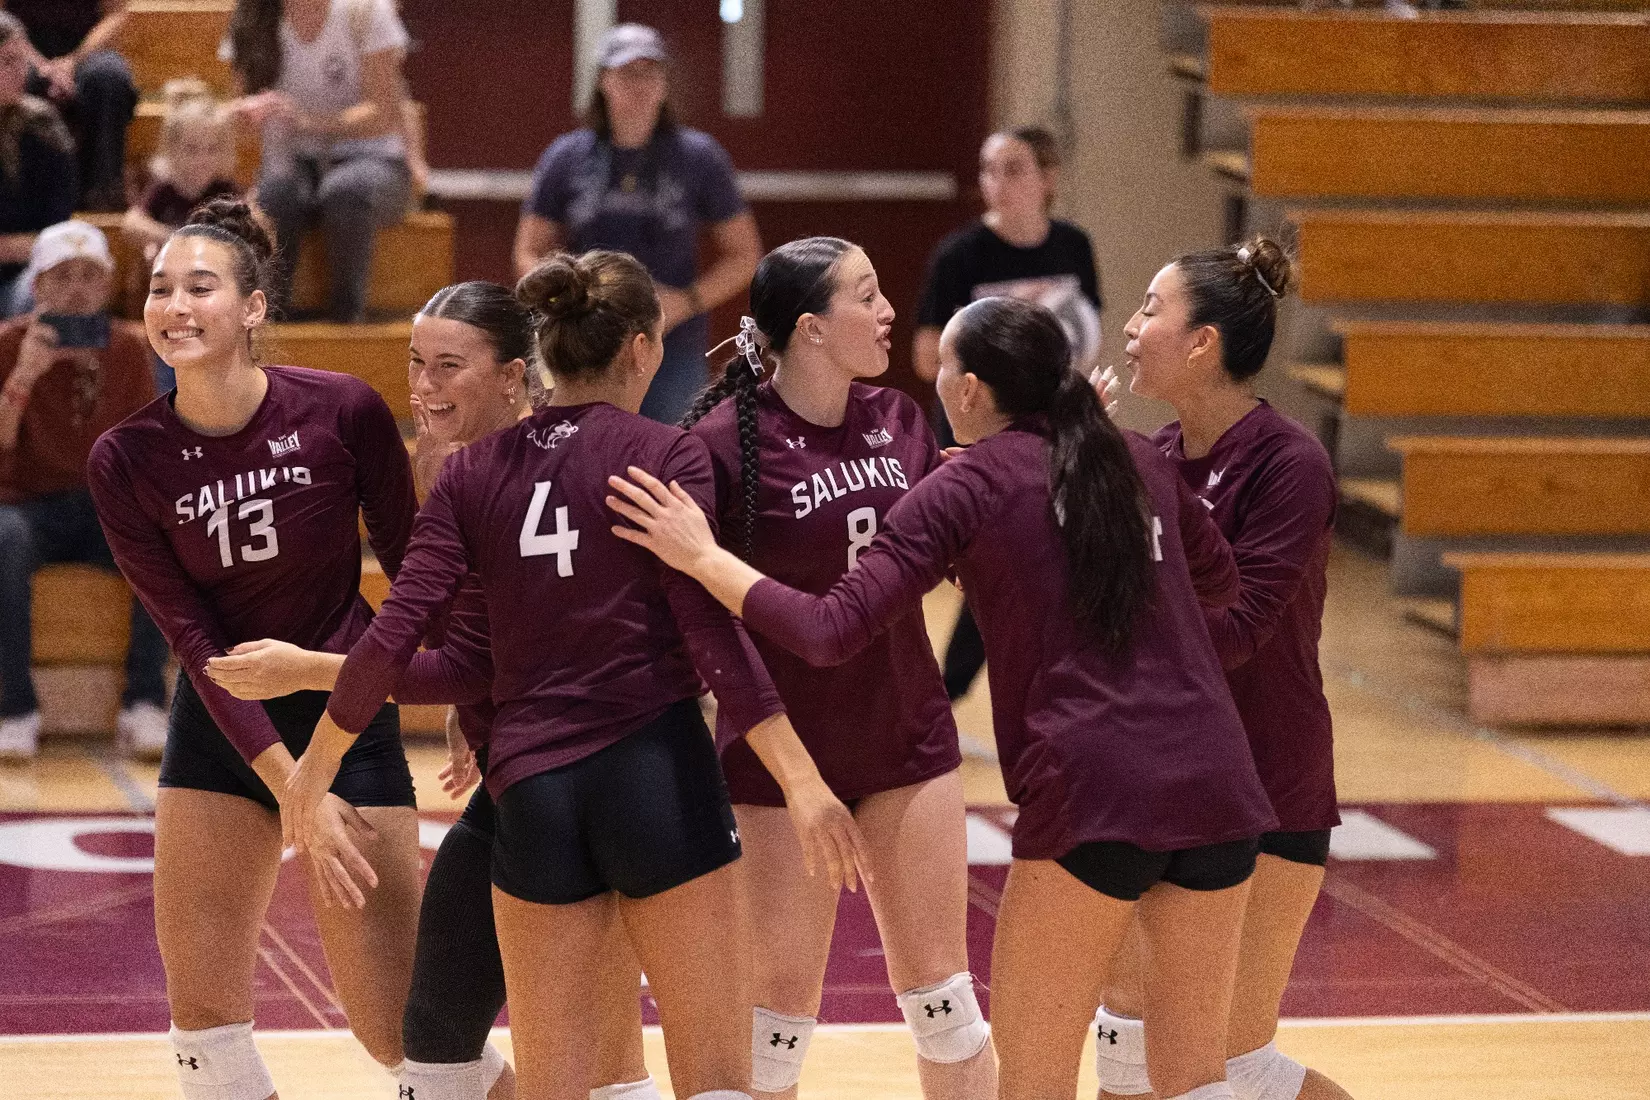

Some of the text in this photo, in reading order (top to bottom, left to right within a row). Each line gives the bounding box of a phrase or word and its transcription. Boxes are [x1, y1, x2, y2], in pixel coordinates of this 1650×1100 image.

[267, 430, 301, 455] VALLEY
[862, 427, 893, 446] VALLEY
[790, 456, 909, 519] SALUKIS
[207, 498, 279, 568] 13
[519, 480, 579, 578] 4
[846, 506, 877, 572] 8
